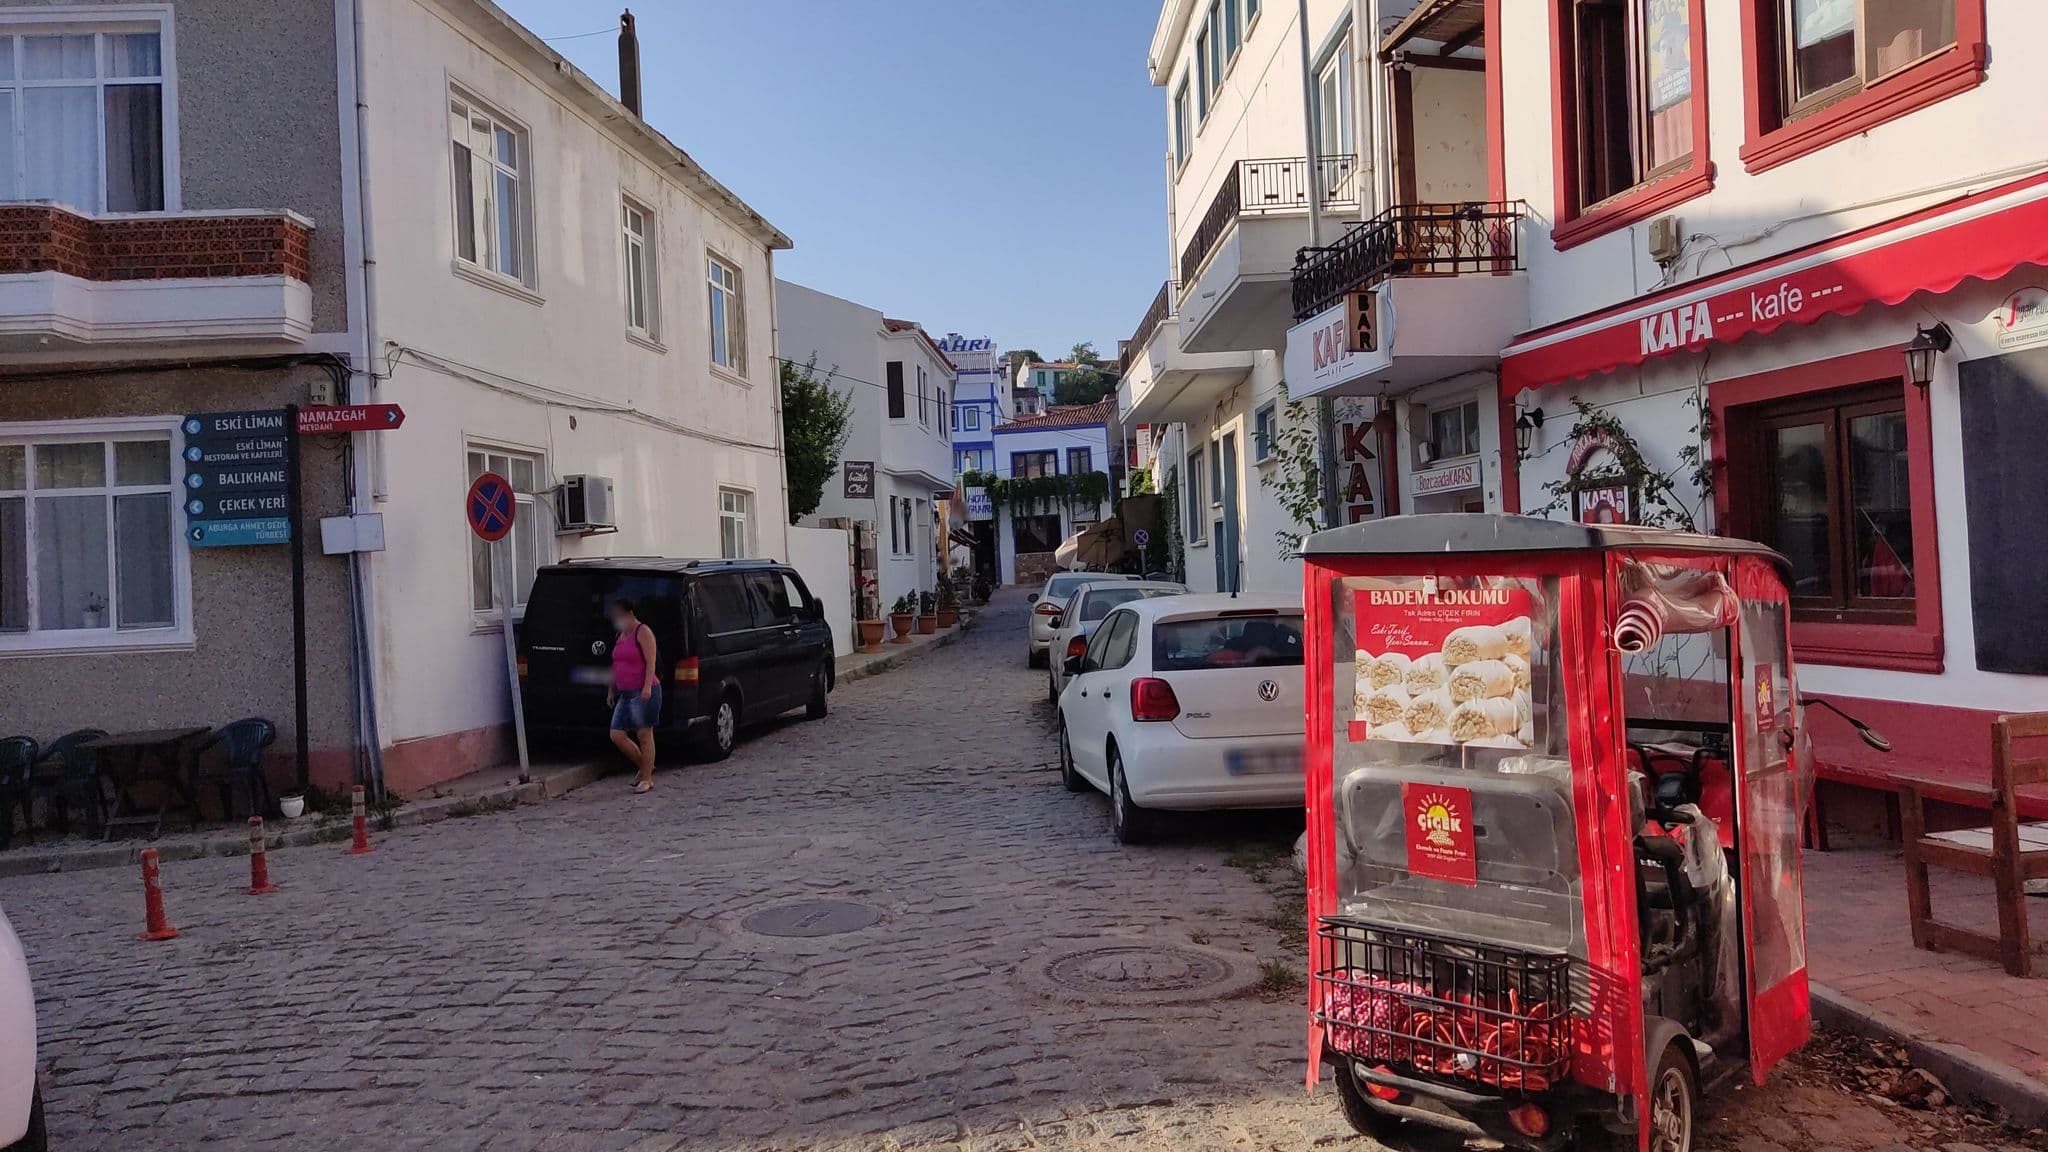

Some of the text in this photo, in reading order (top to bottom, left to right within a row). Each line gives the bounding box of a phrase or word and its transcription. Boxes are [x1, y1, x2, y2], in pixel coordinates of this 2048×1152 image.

[1358, 295, 1371, 348] BAR
[1640, 301, 1713, 355] KAFA
[1751, 283, 1803, 322] kafe
[215, 415, 282, 431] ESKİ LİMAN
[300, 409, 366, 423] NAMAZGAH
[236, 439, 282, 451] ESKİ LİMAN
[219, 471, 285, 485] BALIKHANE
[219, 494, 285, 514] ÇEKEK YERİ
[1583, 489, 1616, 510] KAFA
[1371, 590, 1509, 606] BADEM LOKUMU
